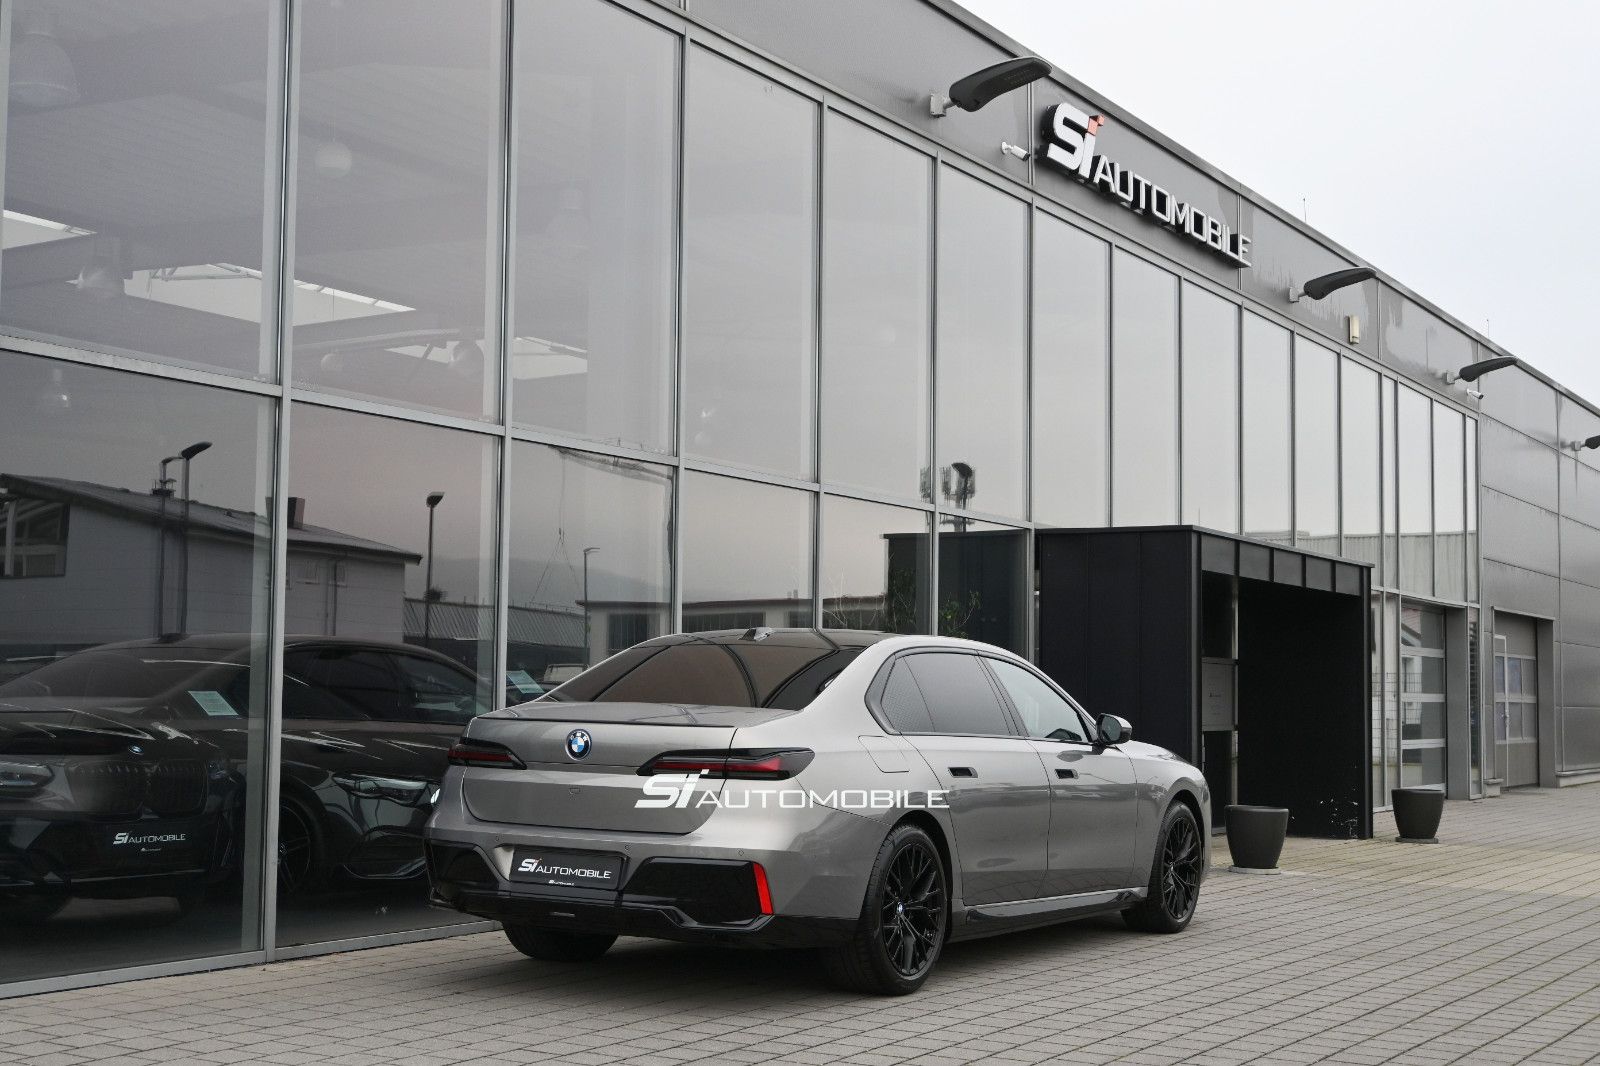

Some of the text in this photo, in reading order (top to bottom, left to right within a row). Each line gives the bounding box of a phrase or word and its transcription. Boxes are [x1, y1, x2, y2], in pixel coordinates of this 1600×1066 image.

[1094, 155, 1252, 268] AUTOMOBILE
[128, 833, 186, 844] AUTOMOBILE
[536, 866, 612, 879] AUTOMOBILE
